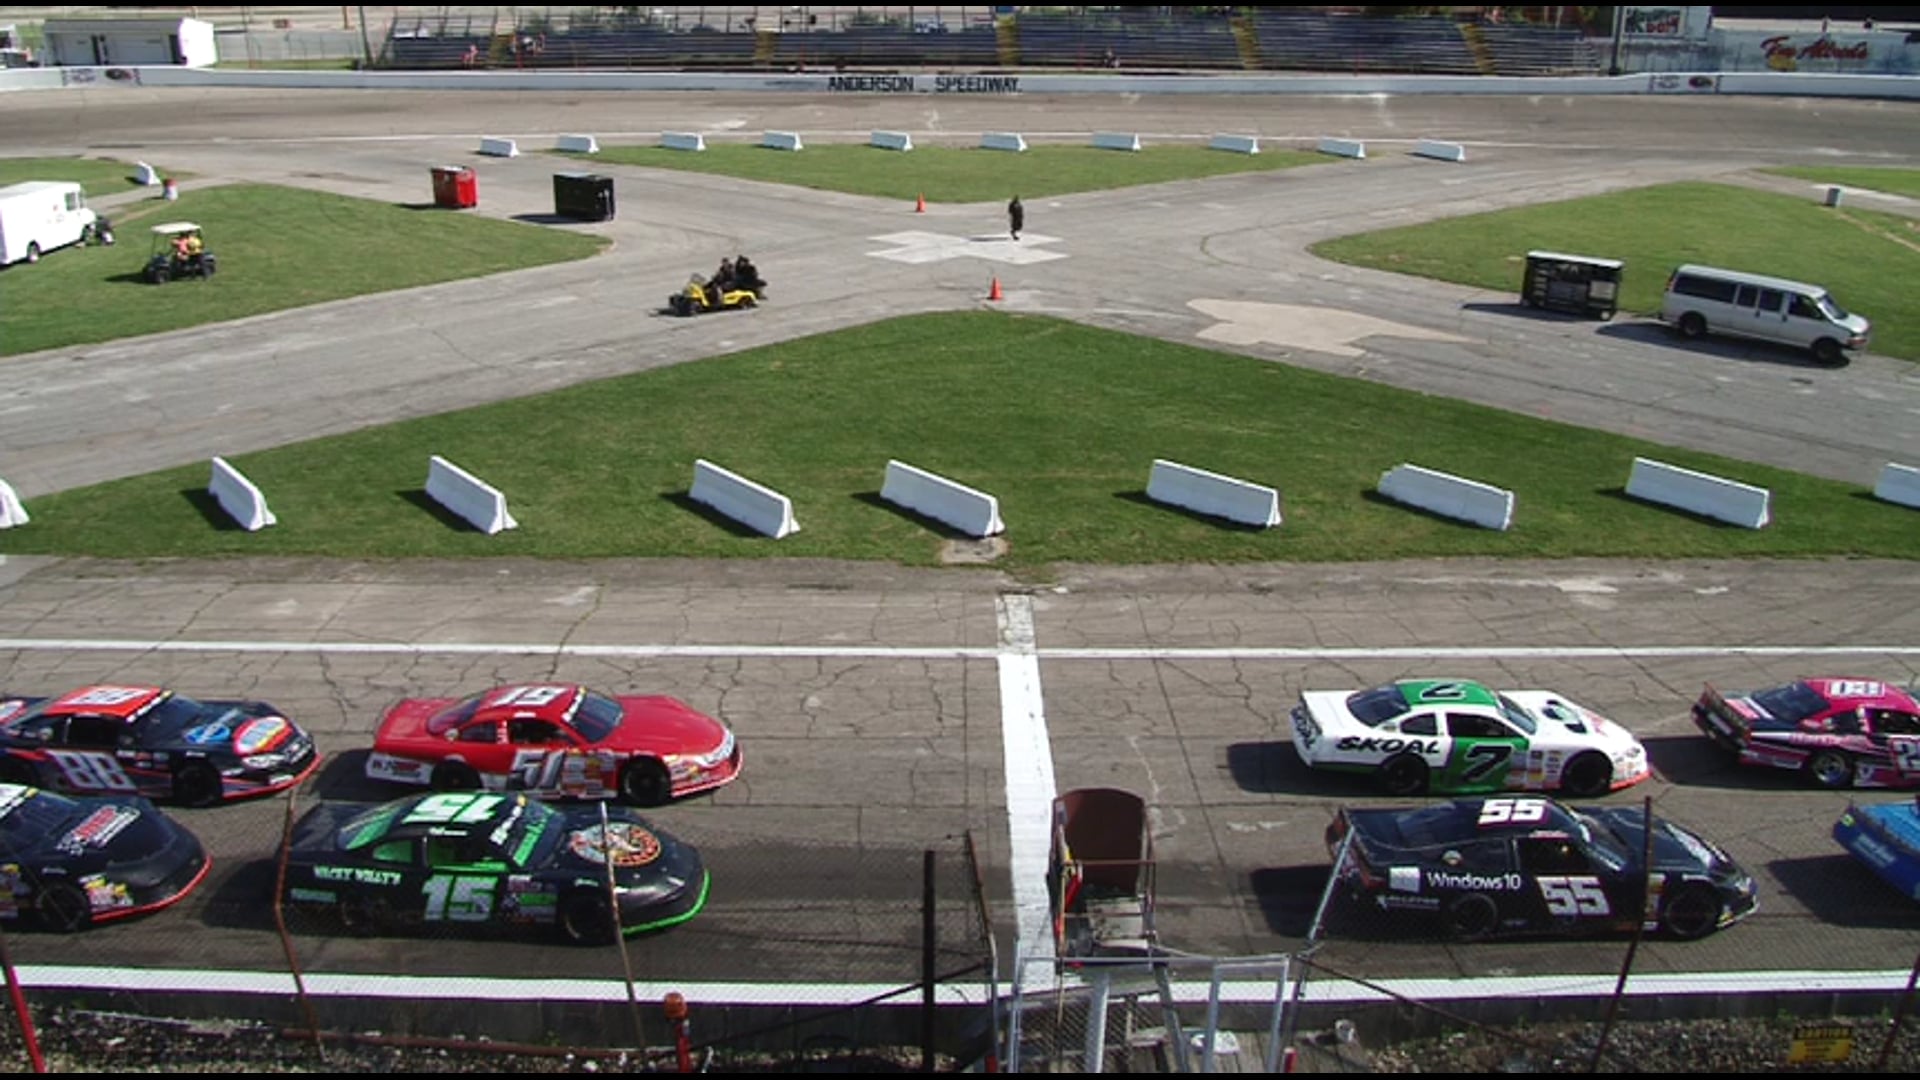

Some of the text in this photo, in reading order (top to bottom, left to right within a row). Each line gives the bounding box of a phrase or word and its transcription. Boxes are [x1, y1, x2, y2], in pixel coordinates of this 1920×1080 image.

[827, 76, 914, 92] ANDERSON
[1336, 735, 1441, 754] SKOAL
[1461, 741, 1513, 783] 7
[46, 750, 139, 791] 88
[508, 749, 567, 791] 51
[1478, 799, 1549, 826] 55
[422, 873, 499, 920] 15
[1535, 875, 1610, 916] 55
